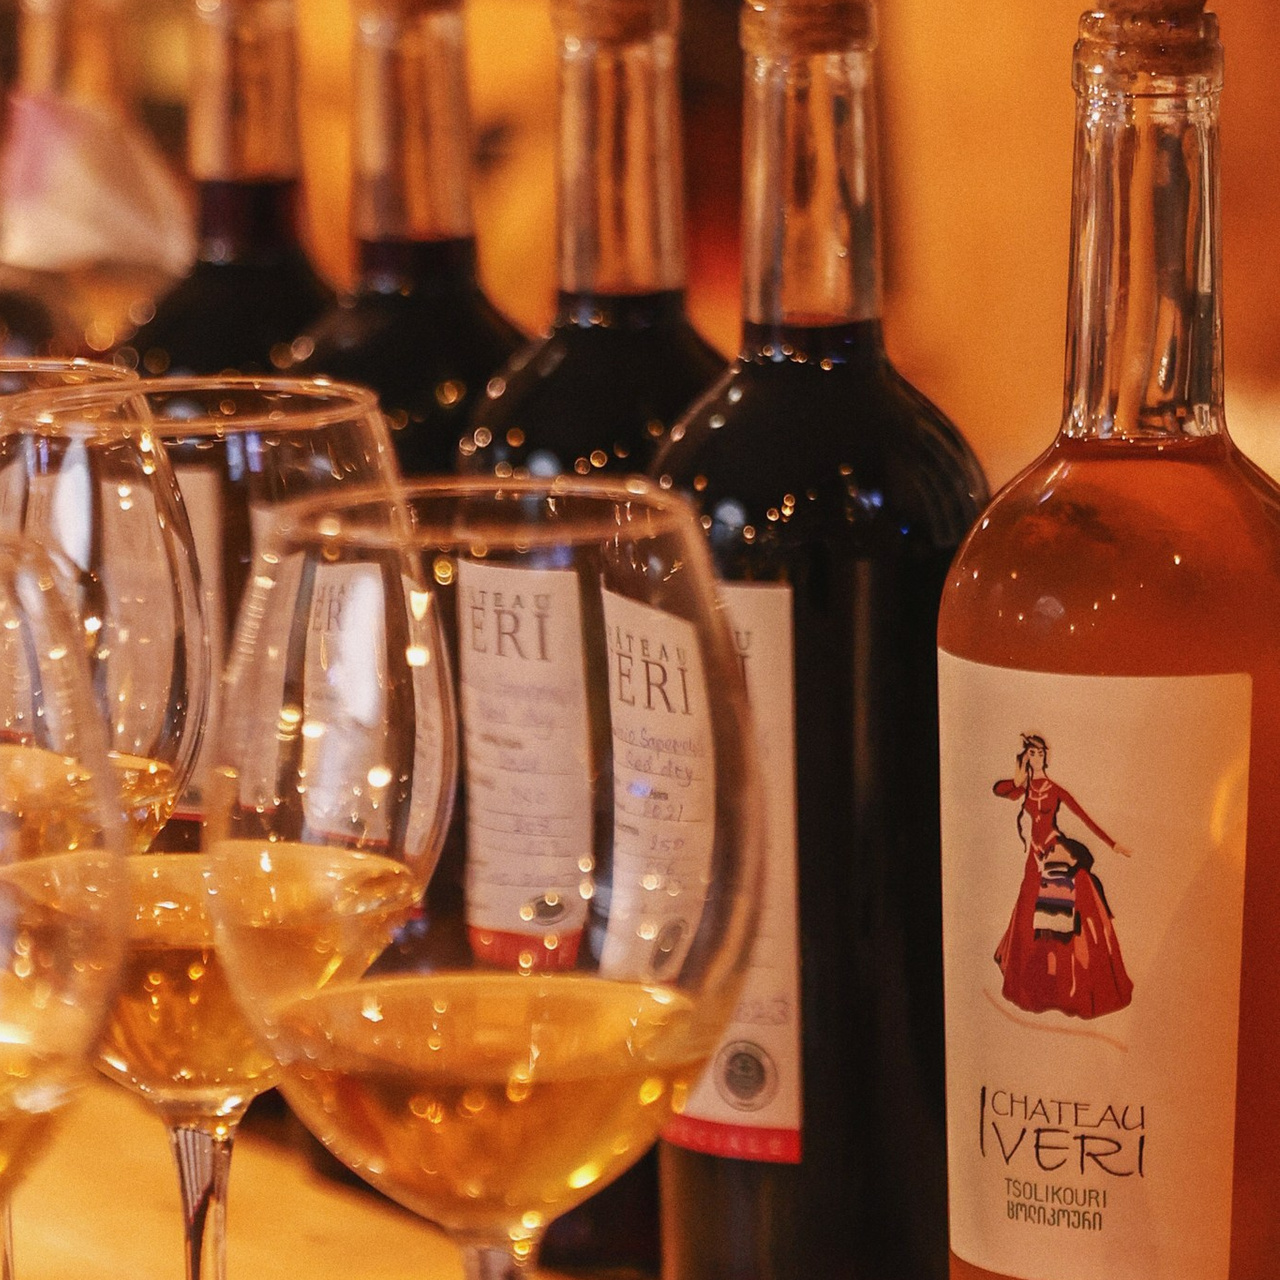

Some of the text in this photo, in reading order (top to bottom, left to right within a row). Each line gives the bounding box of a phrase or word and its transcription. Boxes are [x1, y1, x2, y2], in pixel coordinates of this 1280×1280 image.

[470, 605, 552, 662] ERI
[610, 625, 687, 665] ATEAU
[615, 651, 693, 716] ERI
[991, 1090, 1145, 1131] CHATEAU
[1004, 1177, 1107, 1209] TSOLIKOURI
[1006, 1200, 1103, 1231] ცოლიკოური
